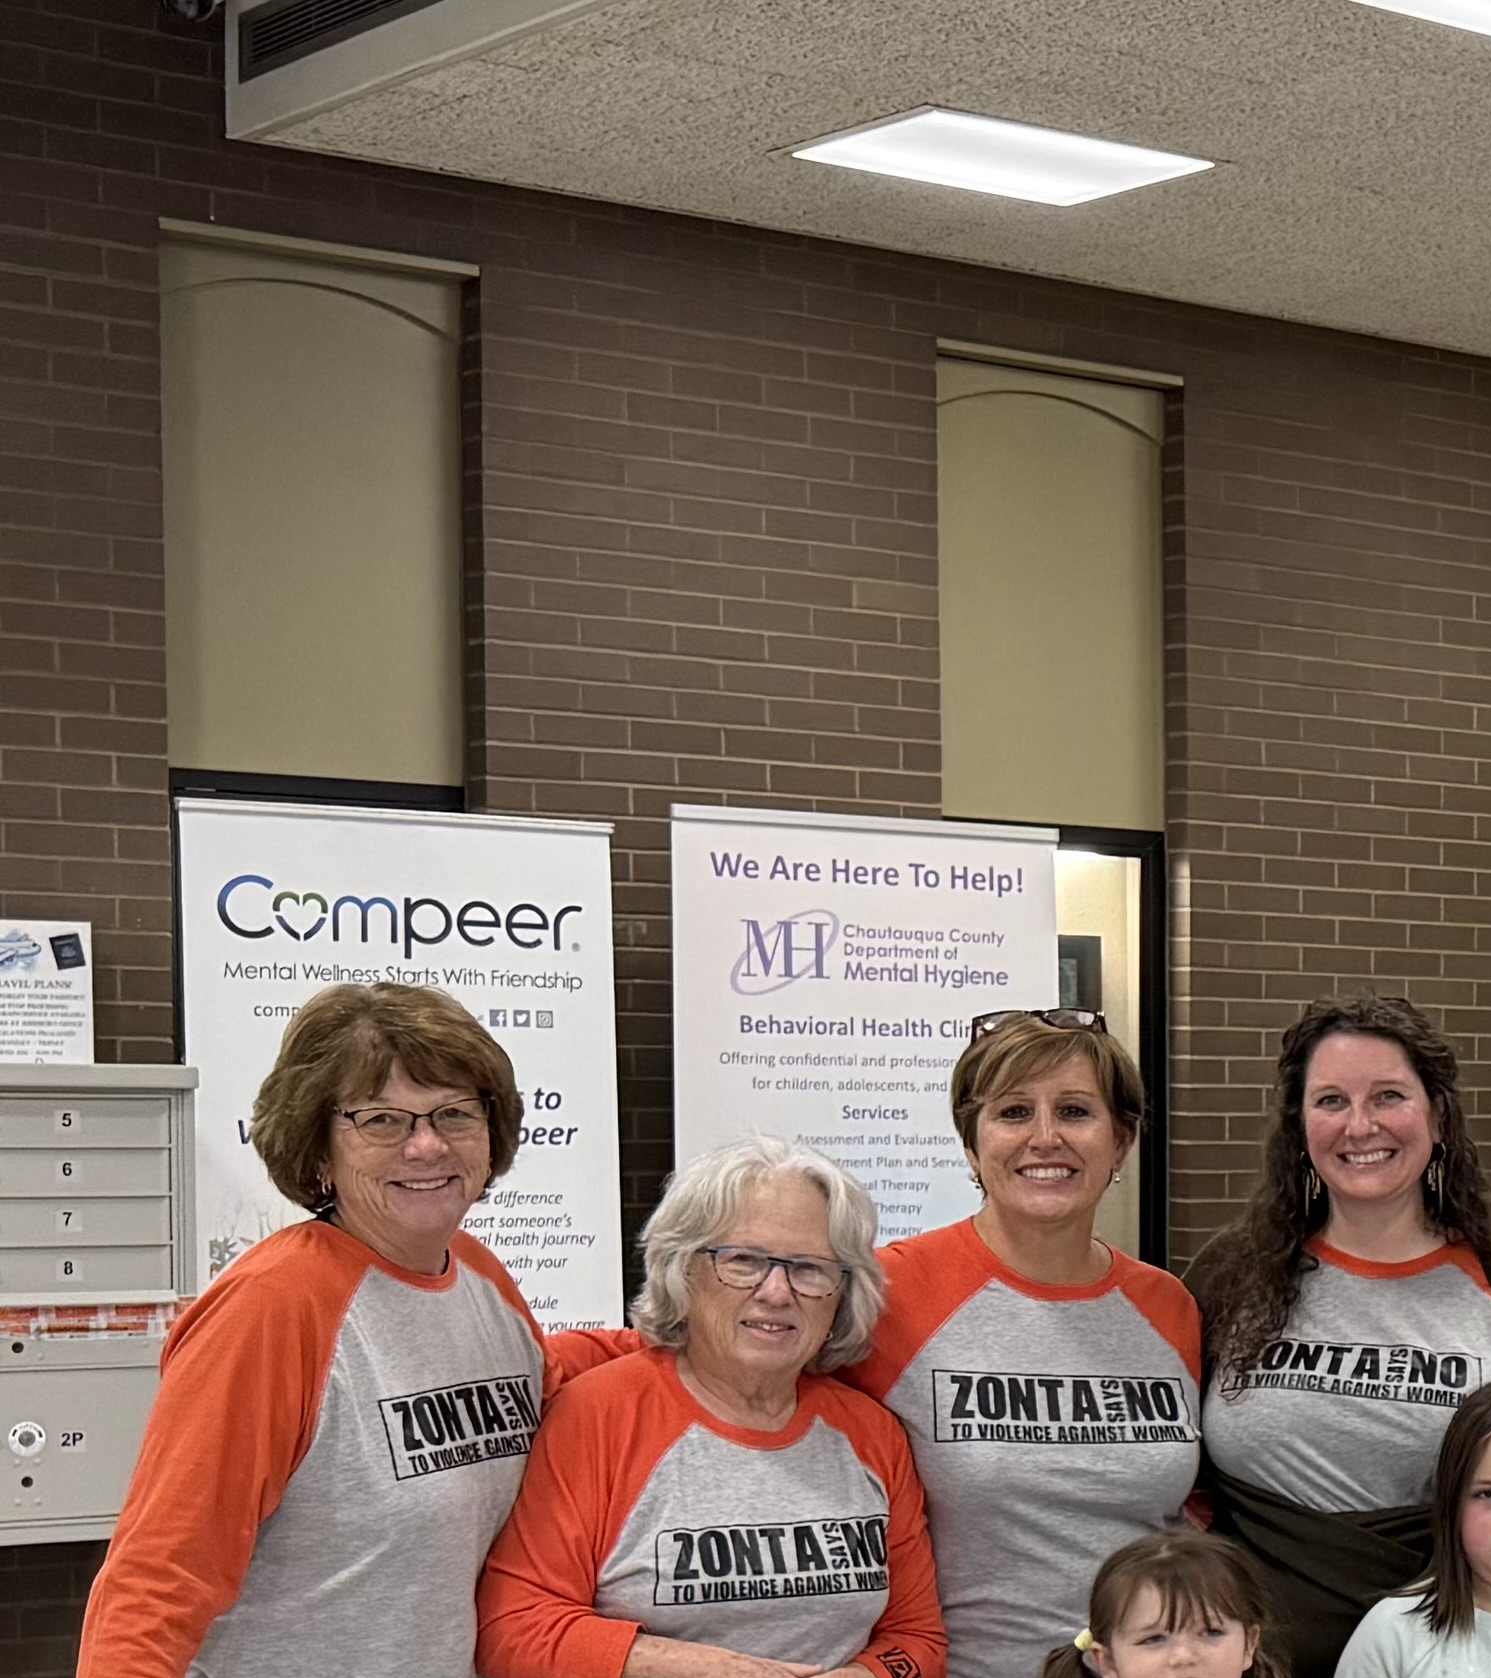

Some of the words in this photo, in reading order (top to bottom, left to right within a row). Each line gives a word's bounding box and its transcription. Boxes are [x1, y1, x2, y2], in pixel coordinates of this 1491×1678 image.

[710, 852, 759, 879] We
[769, 855, 821, 882] Are
[831, 858, 900, 887] Here
[908, 862, 940, 889] To
[950, 865, 1024, 898] Help!
[217, 874, 583, 960] Compeer
[842, 924, 945, 945] Chautauqua
[949, 929, 1005, 948] County
[740, 919, 831, 980] MH
[843, 943, 939, 961] Department
[943, 946, 959, 961] of
[223, 961, 297, 981] Mental
[302, 963, 381, 985] Wellness
[385, 966, 439, 986] Starts
[443, 968, 485, 986] With
[491, 969, 583, 993] Friendship
[843, 961, 919, 983] Mental
[924, 963, 1009, 989] Hygiene
[739, 1015, 854, 1036] Behavioral
[862, 1018, 932, 1038] Health
[719, 1052, 776, 1068] Offering
[779, 1053, 858, 1068] confidential
[861, 1054, 886, 1068] and
[752, 1077, 771, 1090] for
[775, 1078, 833, 1092] children,
[923, 1079, 948, 1092] and
[533, 1087, 562, 1110] to
[61, 1112, 72, 1127] 5
[842, 1105, 909, 1120] Services
[795, 1134, 865, 1146] Assessment
[868, 1134, 891, 1146] and
[895, 1133, 956, 1146] Evaluation
[62, 1162, 72, 1176] 6
[876, 1156, 903, 1168] Plan
[905, 1156, 929, 1168] and
[881, 1179, 930, 1193] Therapy
[493, 1190, 563, 1207] difference
[62, 1211, 72, 1227] 7
[494, 1232, 539, 1247] health
[541, 1234, 596, 1249] journey
[63, 1260, 73, 1275] 8
[536, 1256, 568, 1275] your
[1249, 1340, 1381, 1381] ONTA
[1384, 1347, 1409, 1384] SAYS
[1408, 1348, 1468, 1389] NO
[1254, 1372, 1327, 1391] VIOLENCE
[1330, 1378, 1400, 1399] AGAINST
[950, 1374, 1103, 1423] ZONTA
[1100, 1378, 1127, 1424] SAYS
[1121, 1380, 1180, 1422] NO
[391, 1384, 508, 1452] ZONTA
[61, 1432, 84, 1447] 2P
[950, 1423, 973, 1440] TO
[977, 1423, 1053, 1441] VIOLENCE
[1057, 1425, 1126, 1442] AGAINST
[1132, 1425, 1187, 1440] WOMEN
[408, 1453, 429, 1474] TO
[673, 1524, 829, 1581] ZONTA
[822, 1520, 851, 1571] SAYS
[841, 1517, 888, 1569] NO
[672, 1583, 694, 1604] TO
[701, 1578, 779, 1601] VIOLENCE
[783, 1572, 852, 1596] AGAINST
